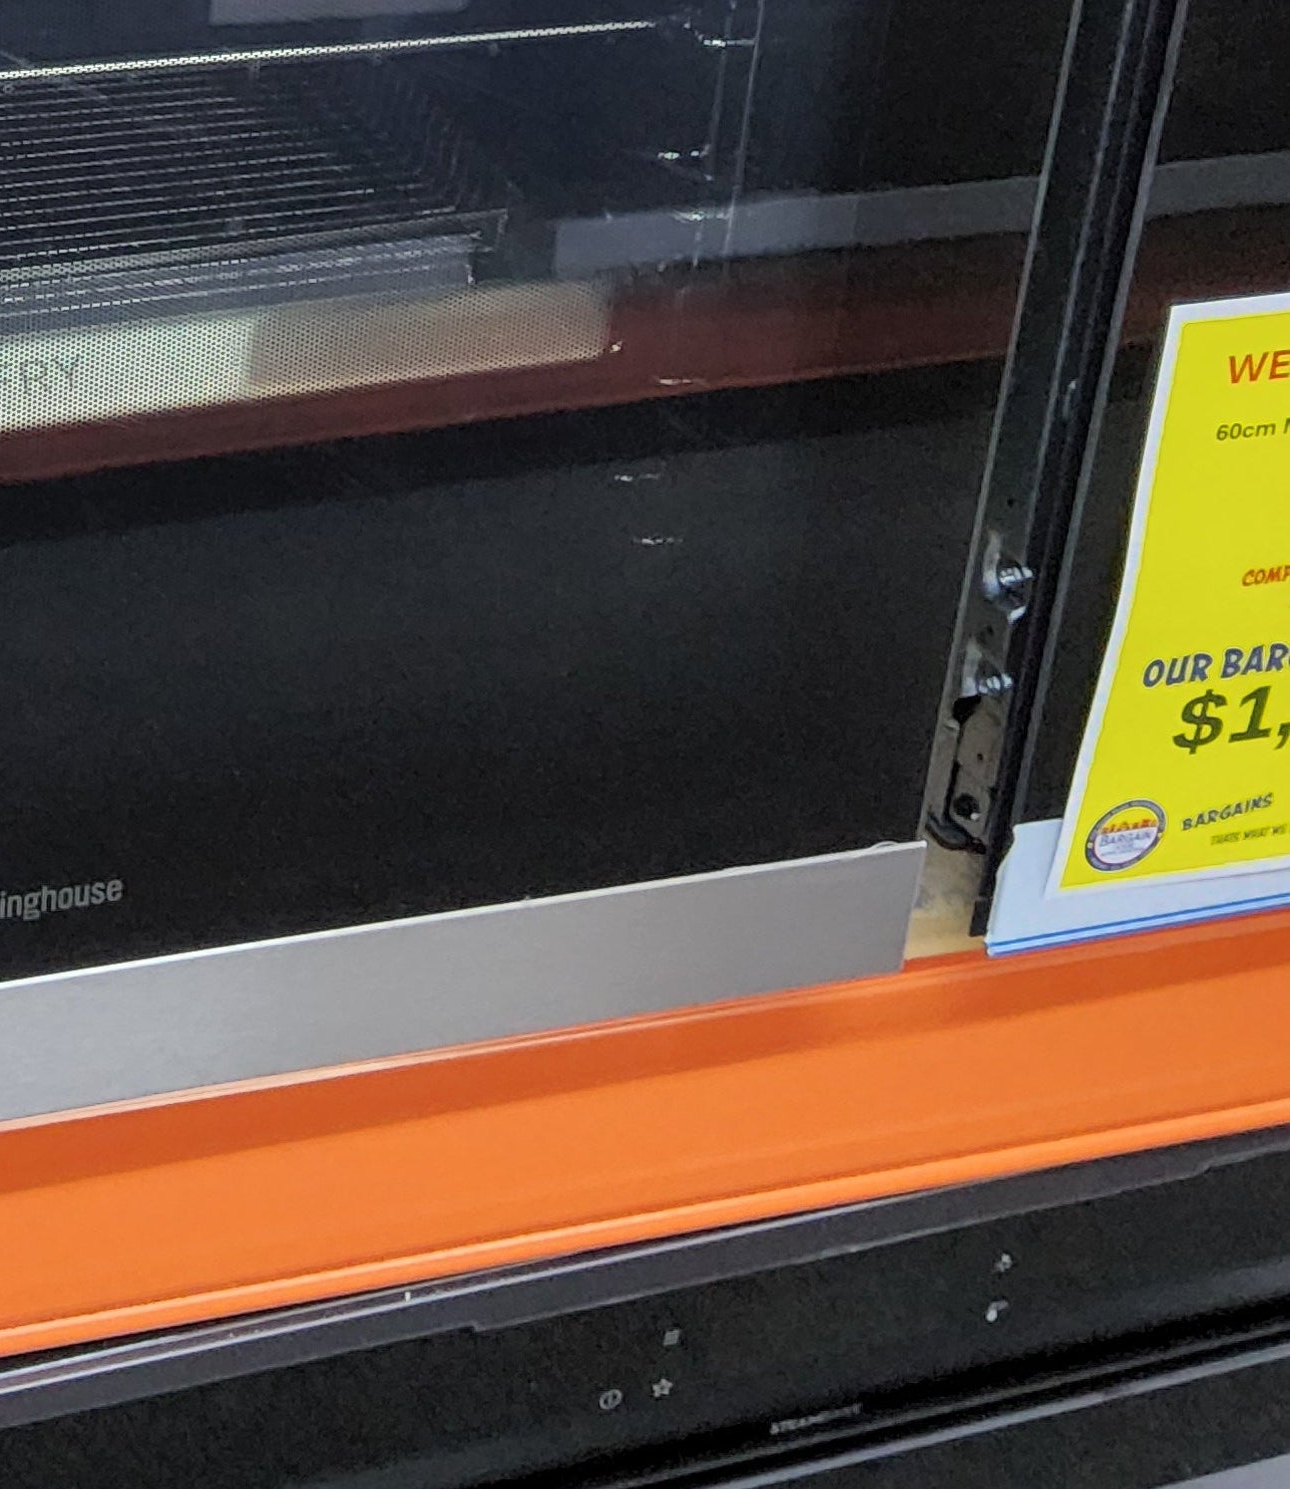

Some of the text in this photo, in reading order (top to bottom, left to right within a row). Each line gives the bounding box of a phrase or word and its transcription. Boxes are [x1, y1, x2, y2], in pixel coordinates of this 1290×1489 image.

[1228, 349, 1290, 384] WE
[1215, 422, 1277, 442] 60cm
[1143, 651, 1214, 688] OUR
[1181, 792, 1273, 831] BARGAINS
